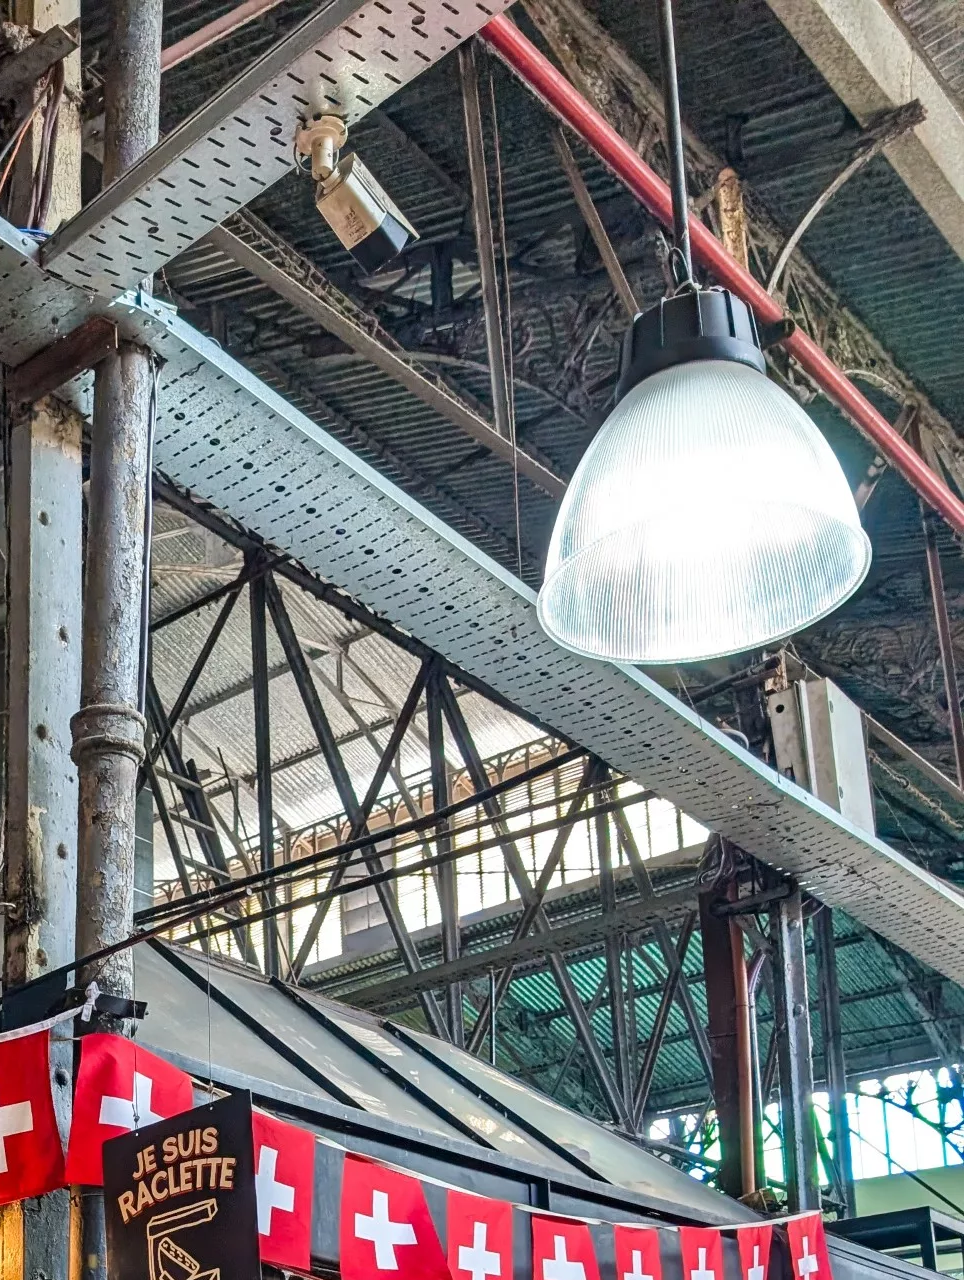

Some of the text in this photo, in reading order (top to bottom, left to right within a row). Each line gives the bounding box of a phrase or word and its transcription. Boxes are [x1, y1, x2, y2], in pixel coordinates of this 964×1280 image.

[132, 1126, 220, 1181] JE SUIS
[117, 1157, 237, 1225] RACLETTE
